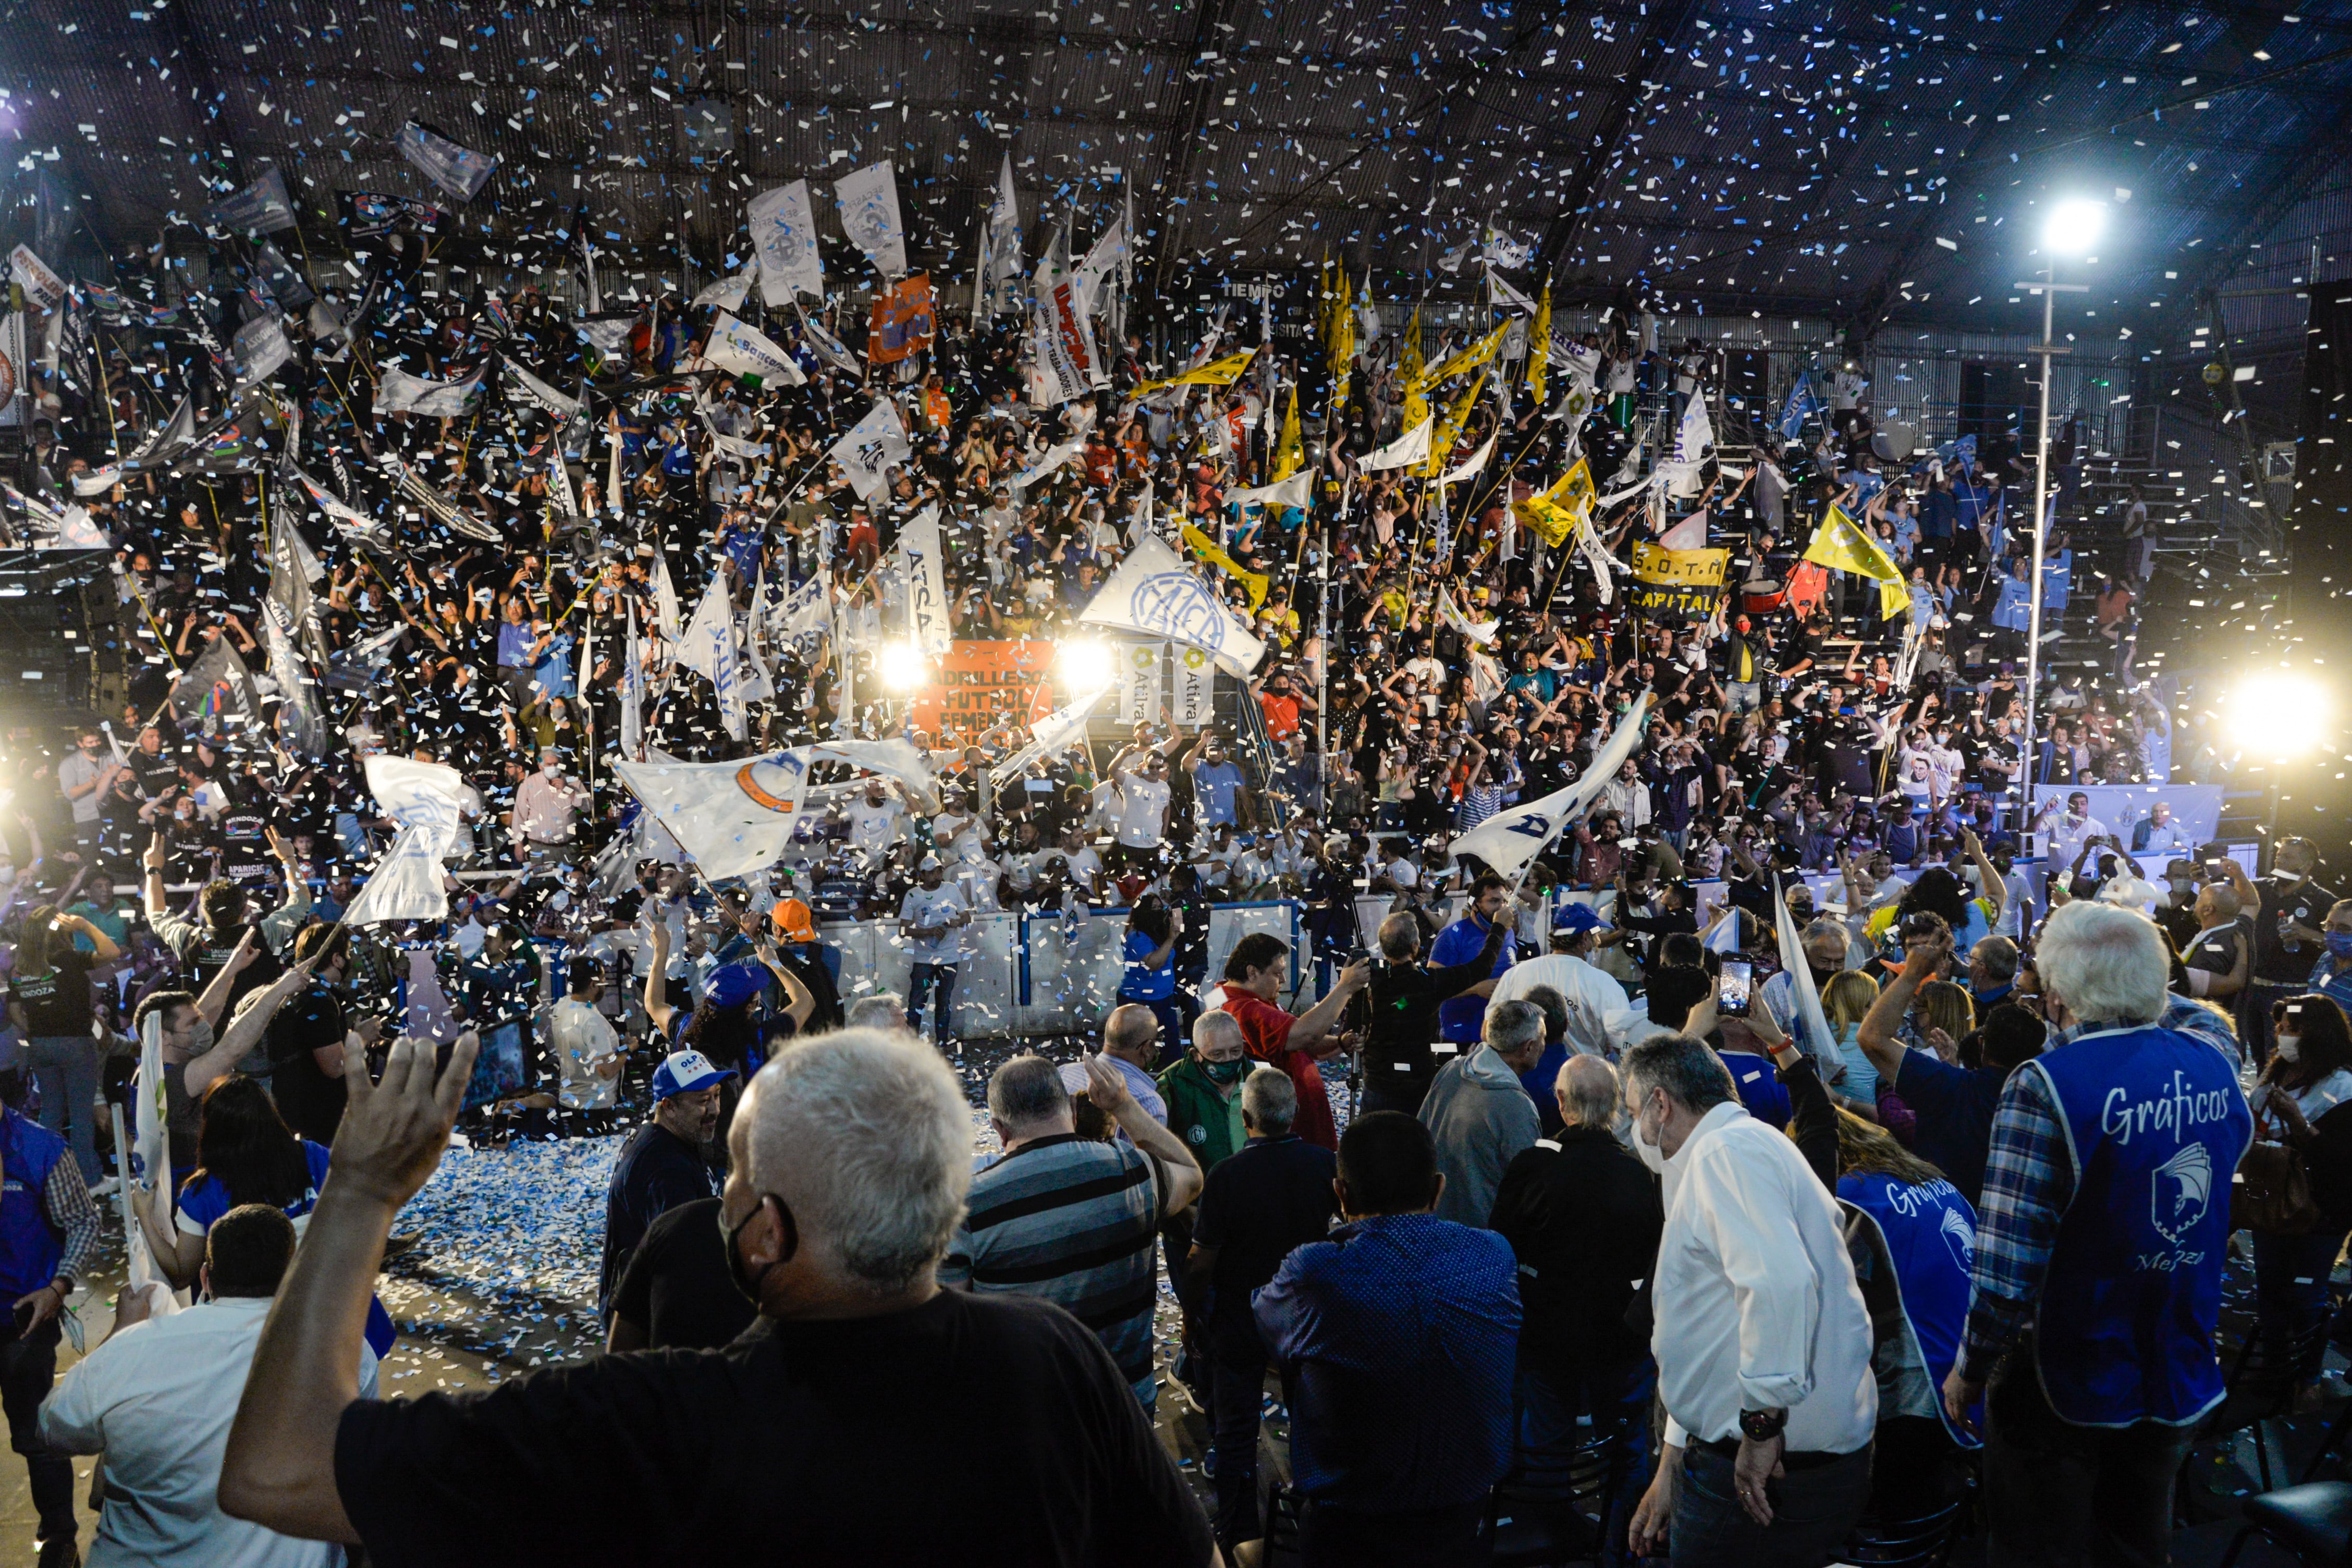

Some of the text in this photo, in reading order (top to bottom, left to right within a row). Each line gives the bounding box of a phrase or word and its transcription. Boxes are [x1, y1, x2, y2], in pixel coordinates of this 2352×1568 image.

[1222, 283, 1284, 298] TIEMPO
[1630, 590, 1711, 612] CAPITAL
[945, 689, 1030, 709] FUTBOL
[1134, 670, 1149, 720] Atilra
[1186, 671, 1200, 721] Atilra
[681, 1055, 697, 1068] OLP
[2102, 1070, 2229, 1145] Gráficos
